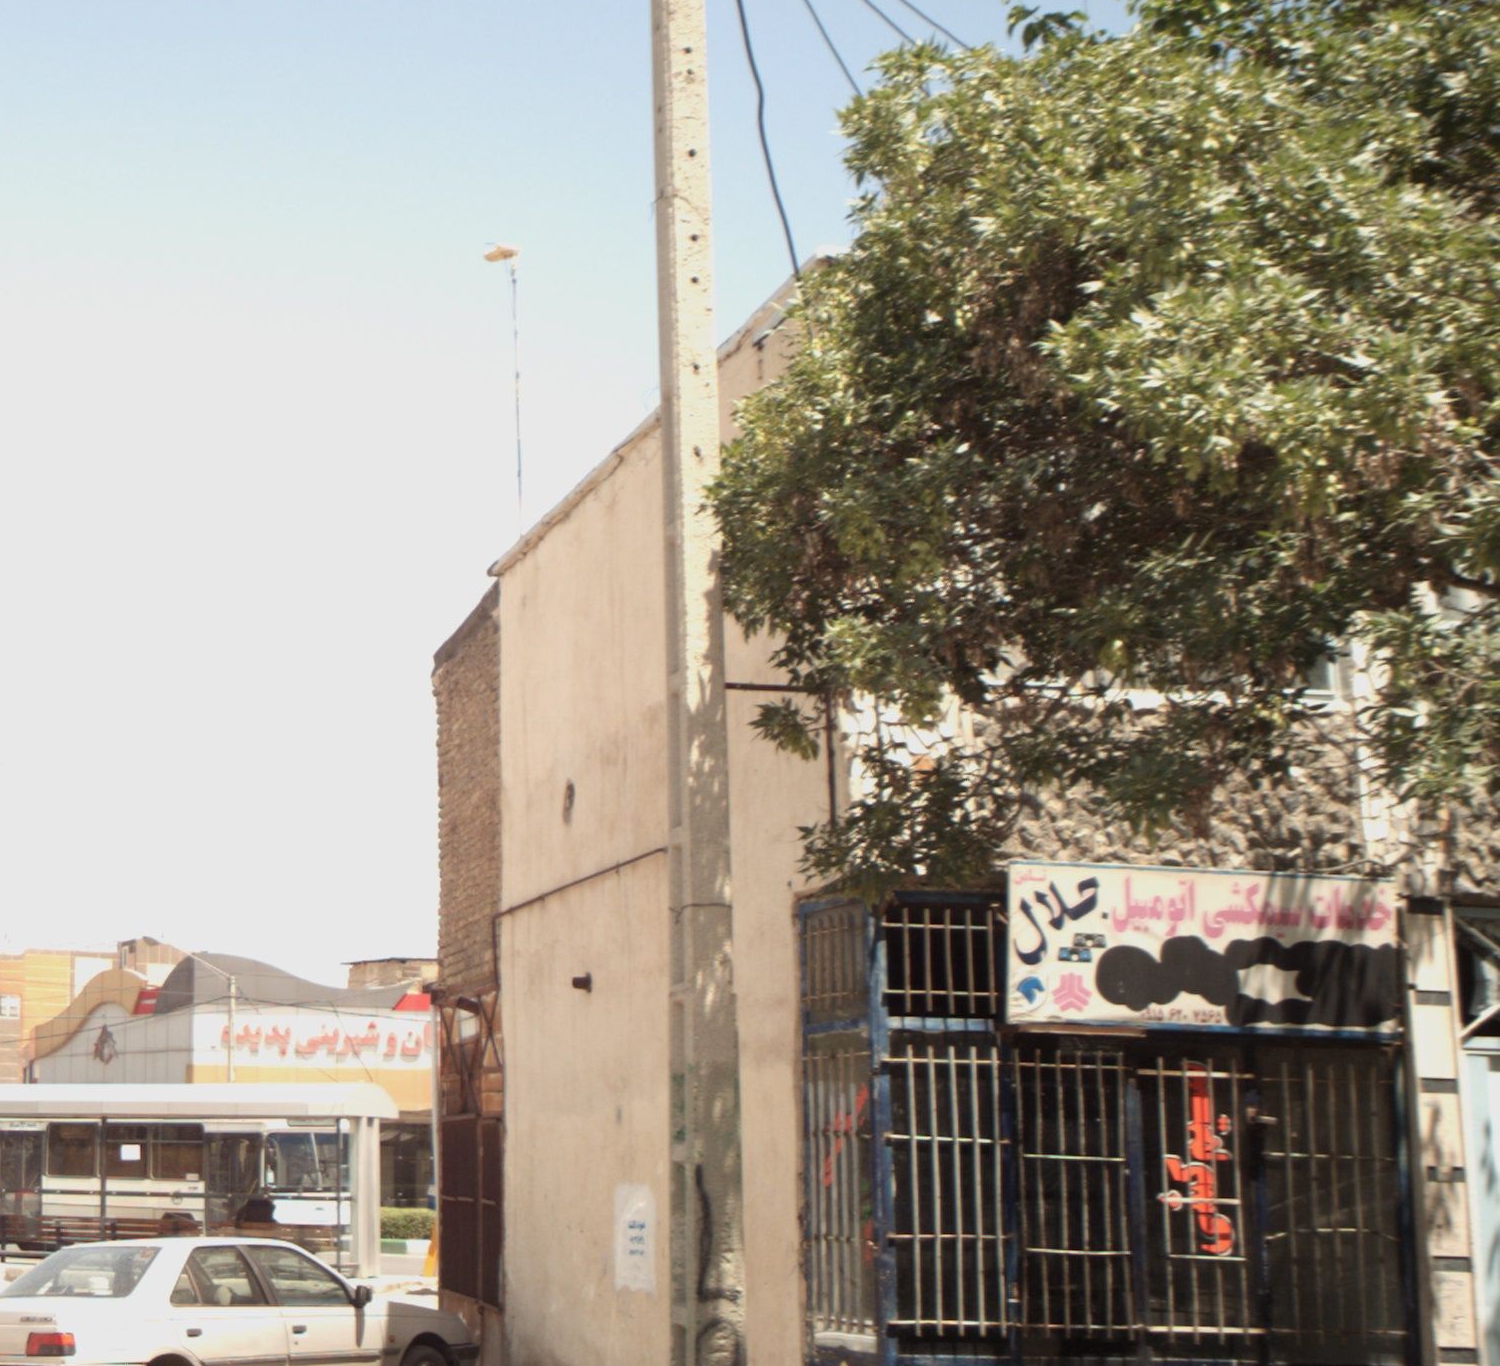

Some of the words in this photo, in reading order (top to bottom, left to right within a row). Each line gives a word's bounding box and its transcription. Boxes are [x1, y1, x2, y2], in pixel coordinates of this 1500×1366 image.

[1112, 876, 1196, 937] اتومبیل
[1203, 882, 1301, 938] سیمکشی
[1311, 885, 1392, 931] خدمات
[296, 1021, 381, 1058] شیرینی
